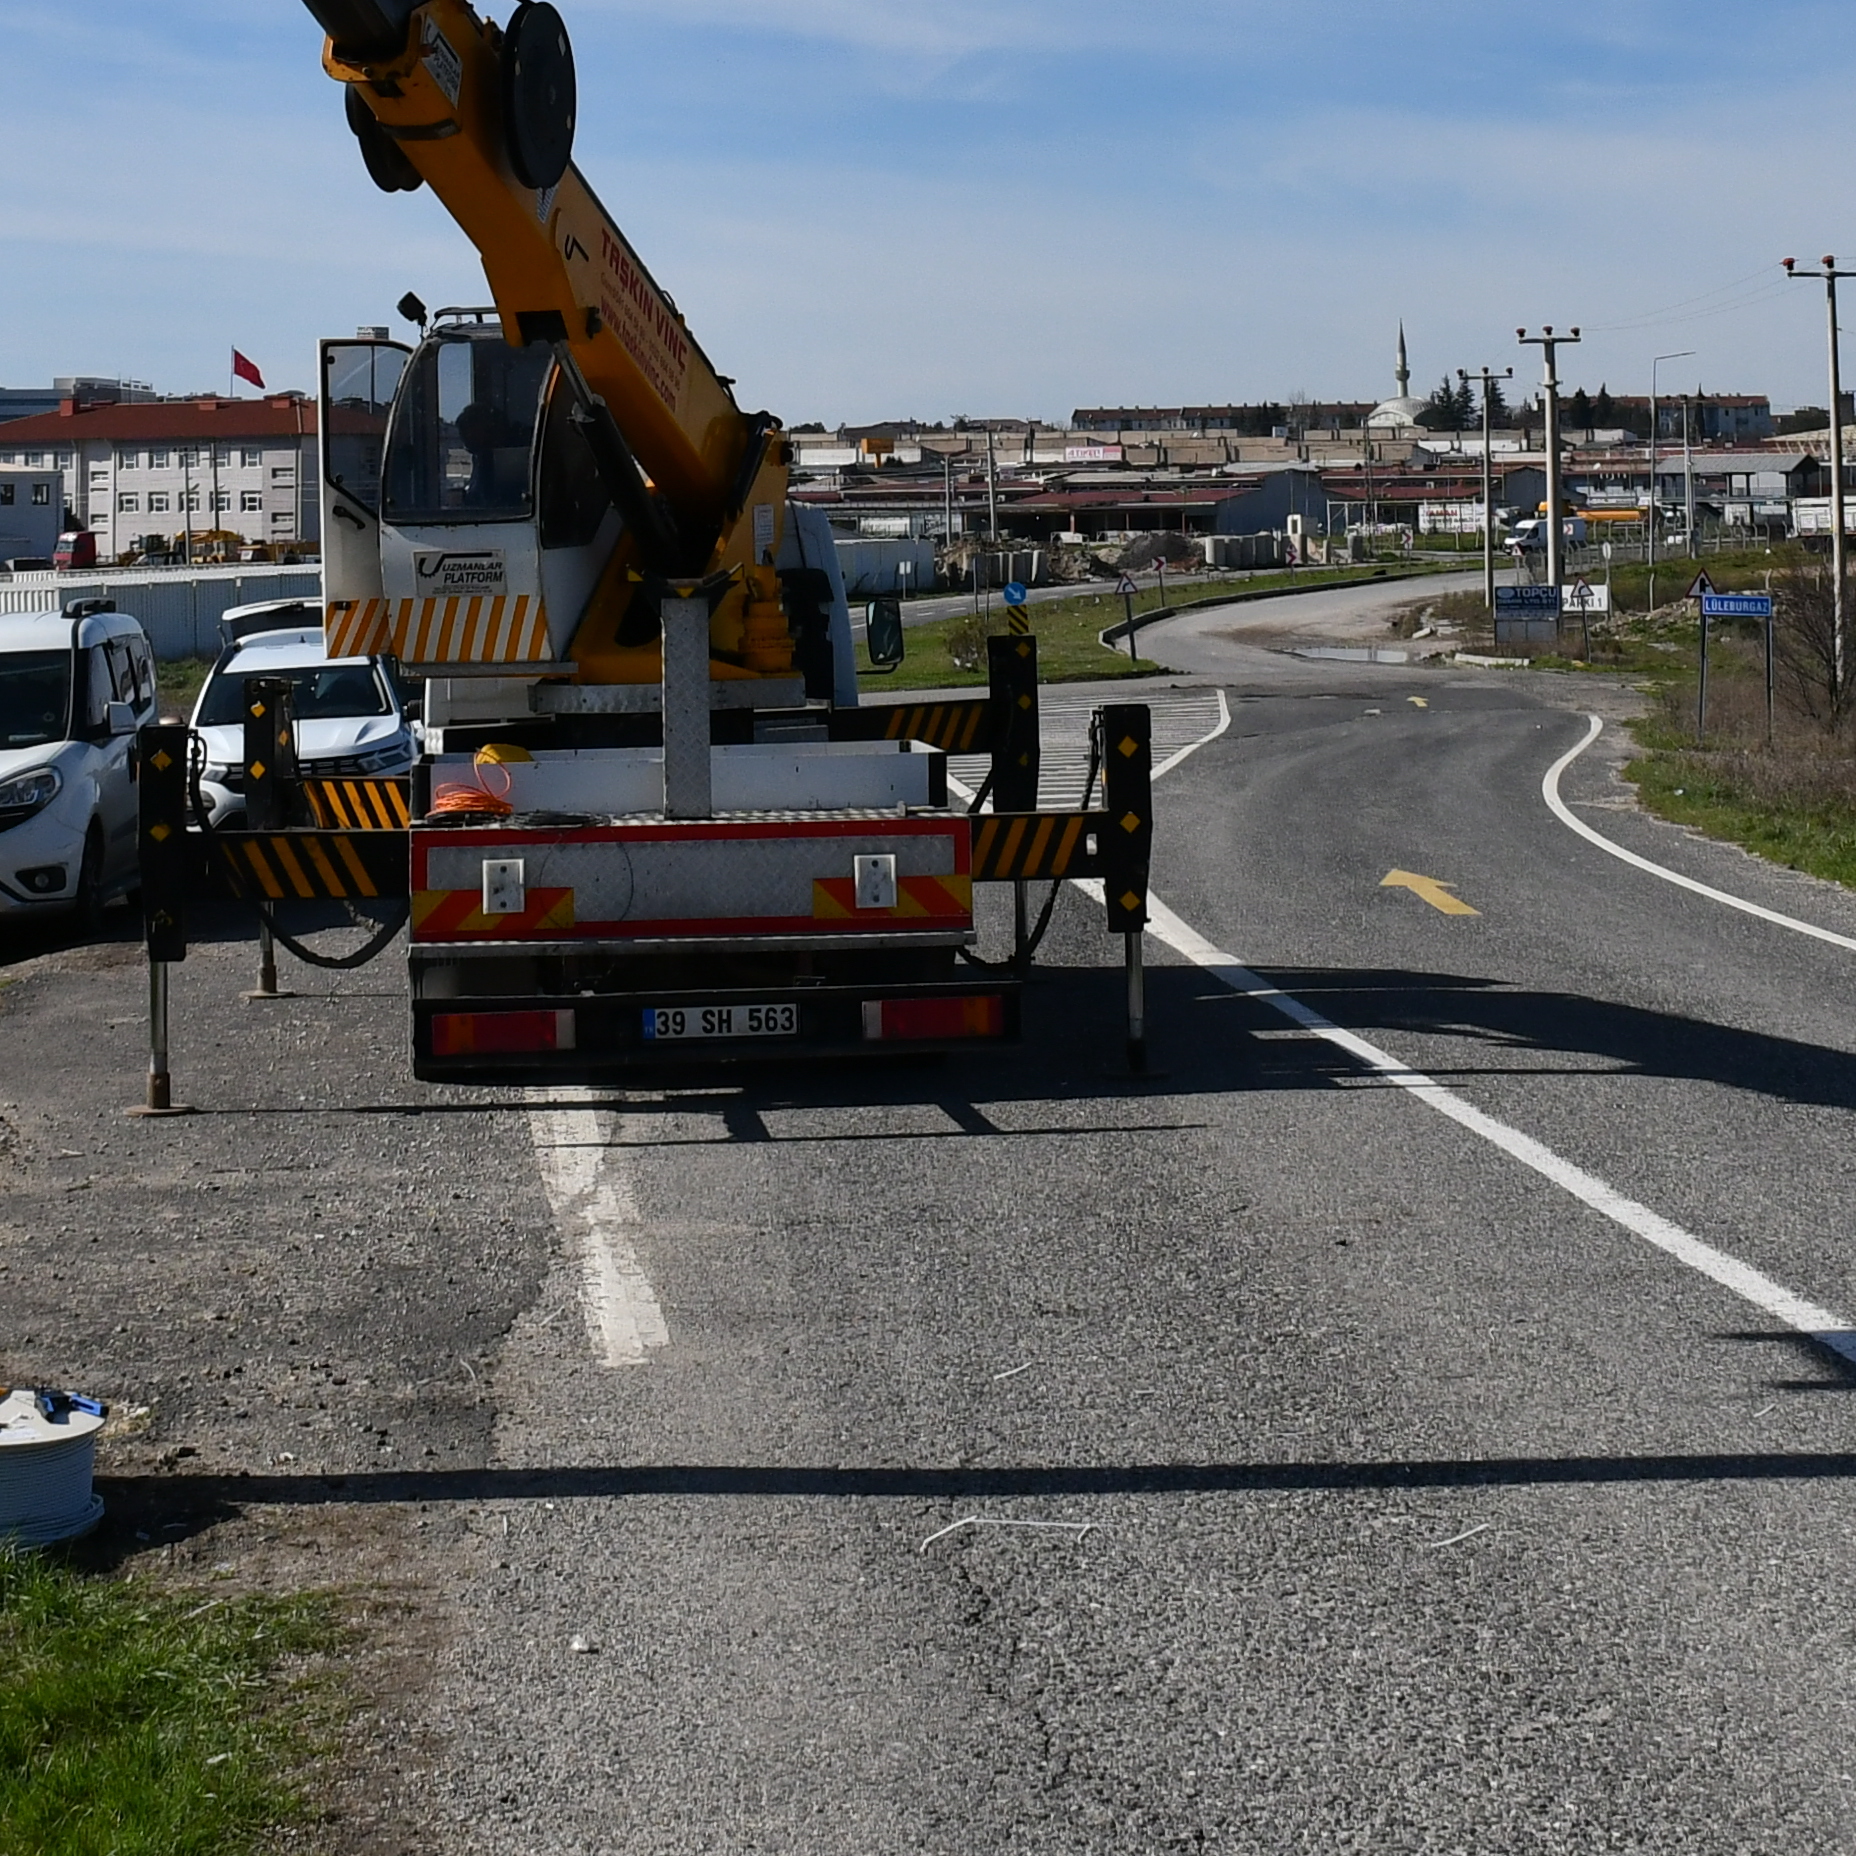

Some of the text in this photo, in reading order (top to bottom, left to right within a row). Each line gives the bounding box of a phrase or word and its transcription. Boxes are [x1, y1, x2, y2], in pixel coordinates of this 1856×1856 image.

[602, 227, 653, 323] TAŞKIN
[442, 561, 503, 572] UZMANLAR
[444, 571, 504, 584] PLATFORM
[1705, 598, 1768, 612] LÜLEBURGAZ
[656, 1010, 686, 1036] 39
[701, 1008, 732, 1034] SH
[748, 1006, 795, 1032] 563
